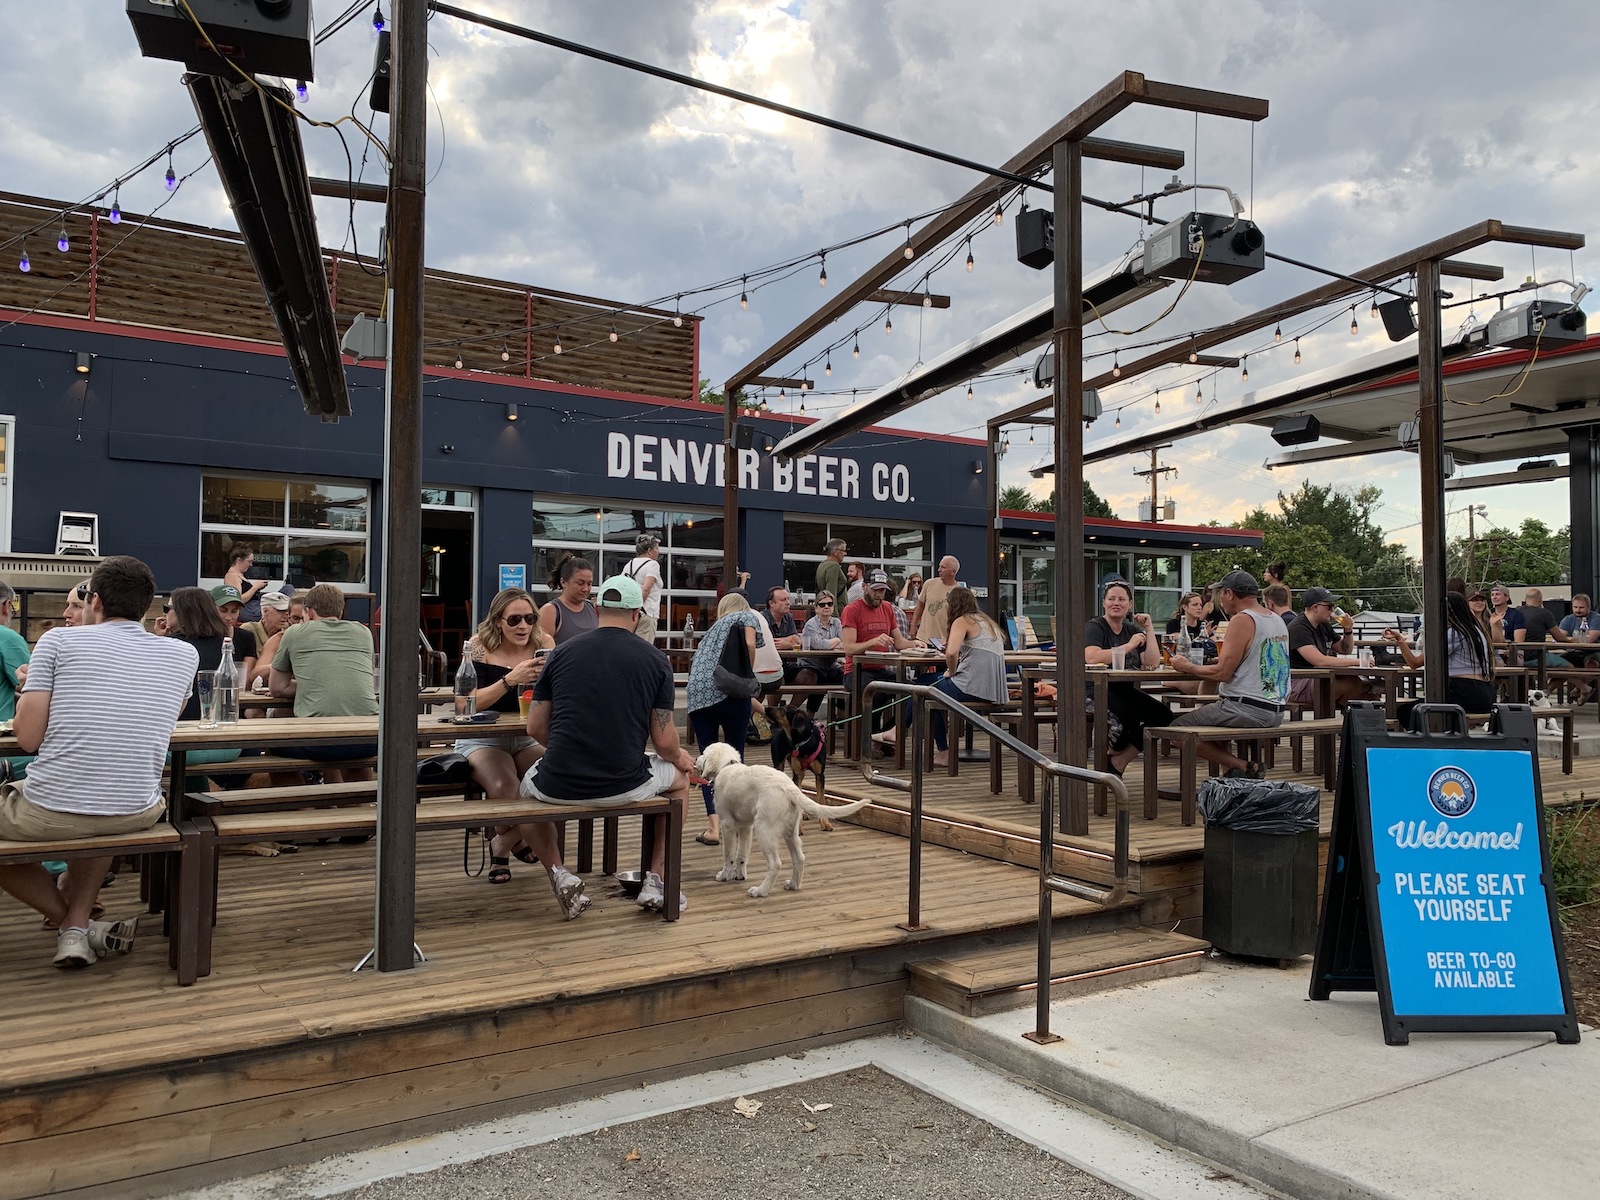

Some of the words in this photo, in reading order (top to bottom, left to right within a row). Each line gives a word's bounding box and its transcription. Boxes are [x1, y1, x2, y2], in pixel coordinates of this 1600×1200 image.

[773, 454, 860, 498] BEER
[872, 462, 915, 503] CO.
[1433, 772, 1450, 790] DENVER
[1450, 772, 1465, 783] BEER
[1462, 780, 1470, 789] CO
[1387, 819, 1524, 850] Welcome!
[1395, 873, 1470, 895] PLEASE
[1476, 873, 1526, 895] SEAT
[1414, 899, 1512, 921] YOURSELF
[1427, 952, 1465, 969] BEER
[1469, 952, 1516, 969] TO-GO
[1435, 971, 1515, 988] AVAILABLE
